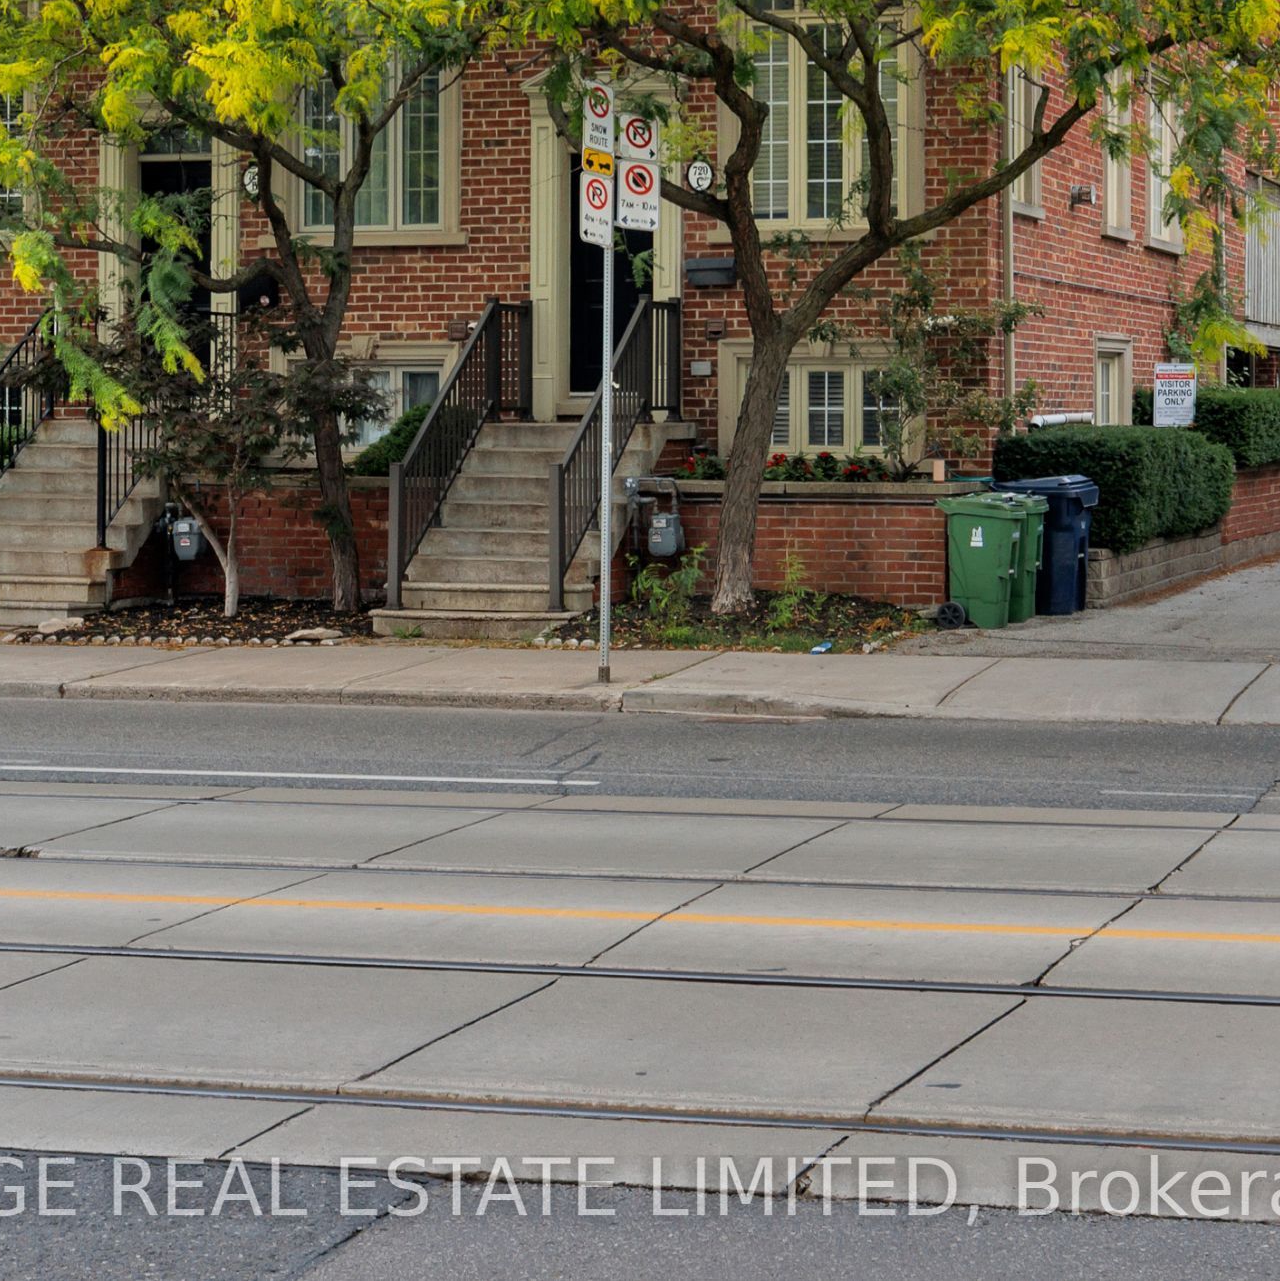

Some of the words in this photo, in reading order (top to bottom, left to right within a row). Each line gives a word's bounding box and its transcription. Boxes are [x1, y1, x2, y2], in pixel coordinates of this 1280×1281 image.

[591, 123, 607, 135] SNOW
[589, 134, 609, 148] ROUTE
[693, 166, 708, 176] 720
[621, 199, 634, 208] 7AM
[1160, 380, 1191, 388] VISITOR
[1157, 389, 1192, 397] PARKING
[1164, 397, 1186, 406] ONLY
